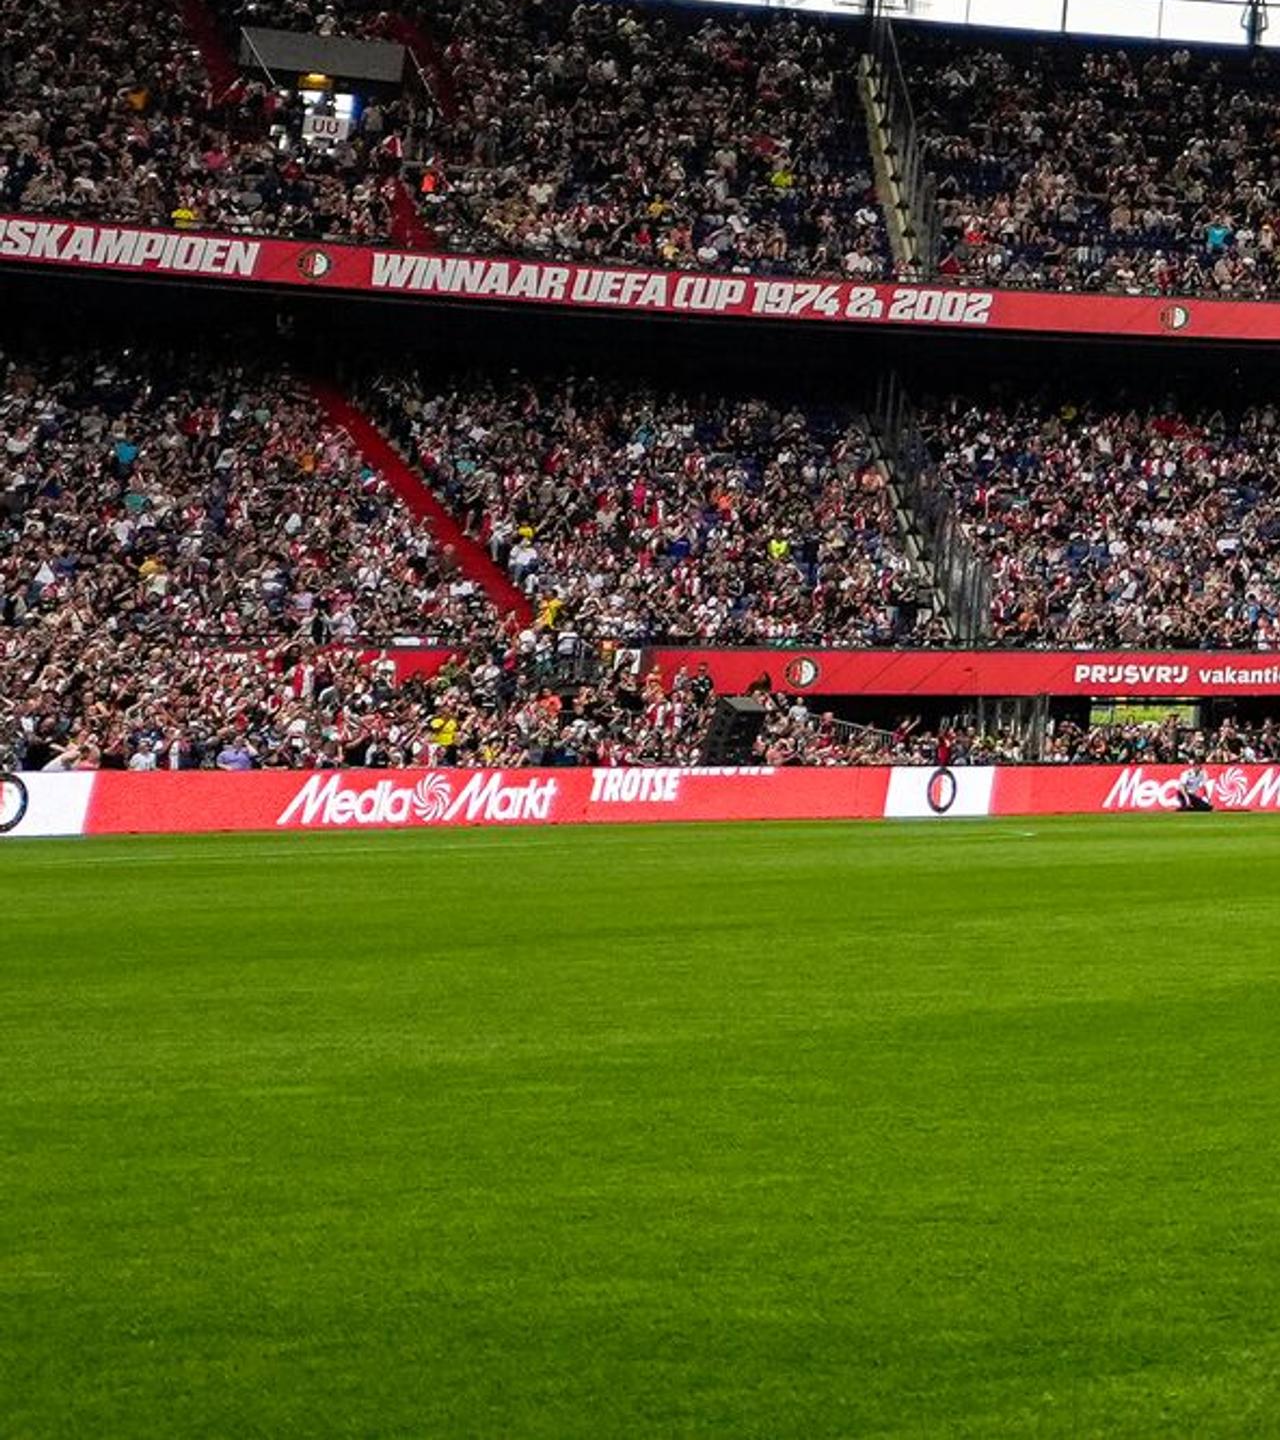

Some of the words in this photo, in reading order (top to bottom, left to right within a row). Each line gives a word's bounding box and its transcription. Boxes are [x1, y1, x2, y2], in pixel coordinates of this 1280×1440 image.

[0, 218, 260, 276] SKAMPIOEN
[371, 253, 566, 301] WINNAAR
[571, 269, 667, 308] UEFA
[673, 276, 748, 311] CUP
[751, 282, 840, 317] 1974
[845, 286, 884, 319] &
[888, 289, 993, 324] 2002
[277, 774, 412, 825] Media
[439, 776, 559, 821] Markt
[590, 768, 680, 802] TROTSE
